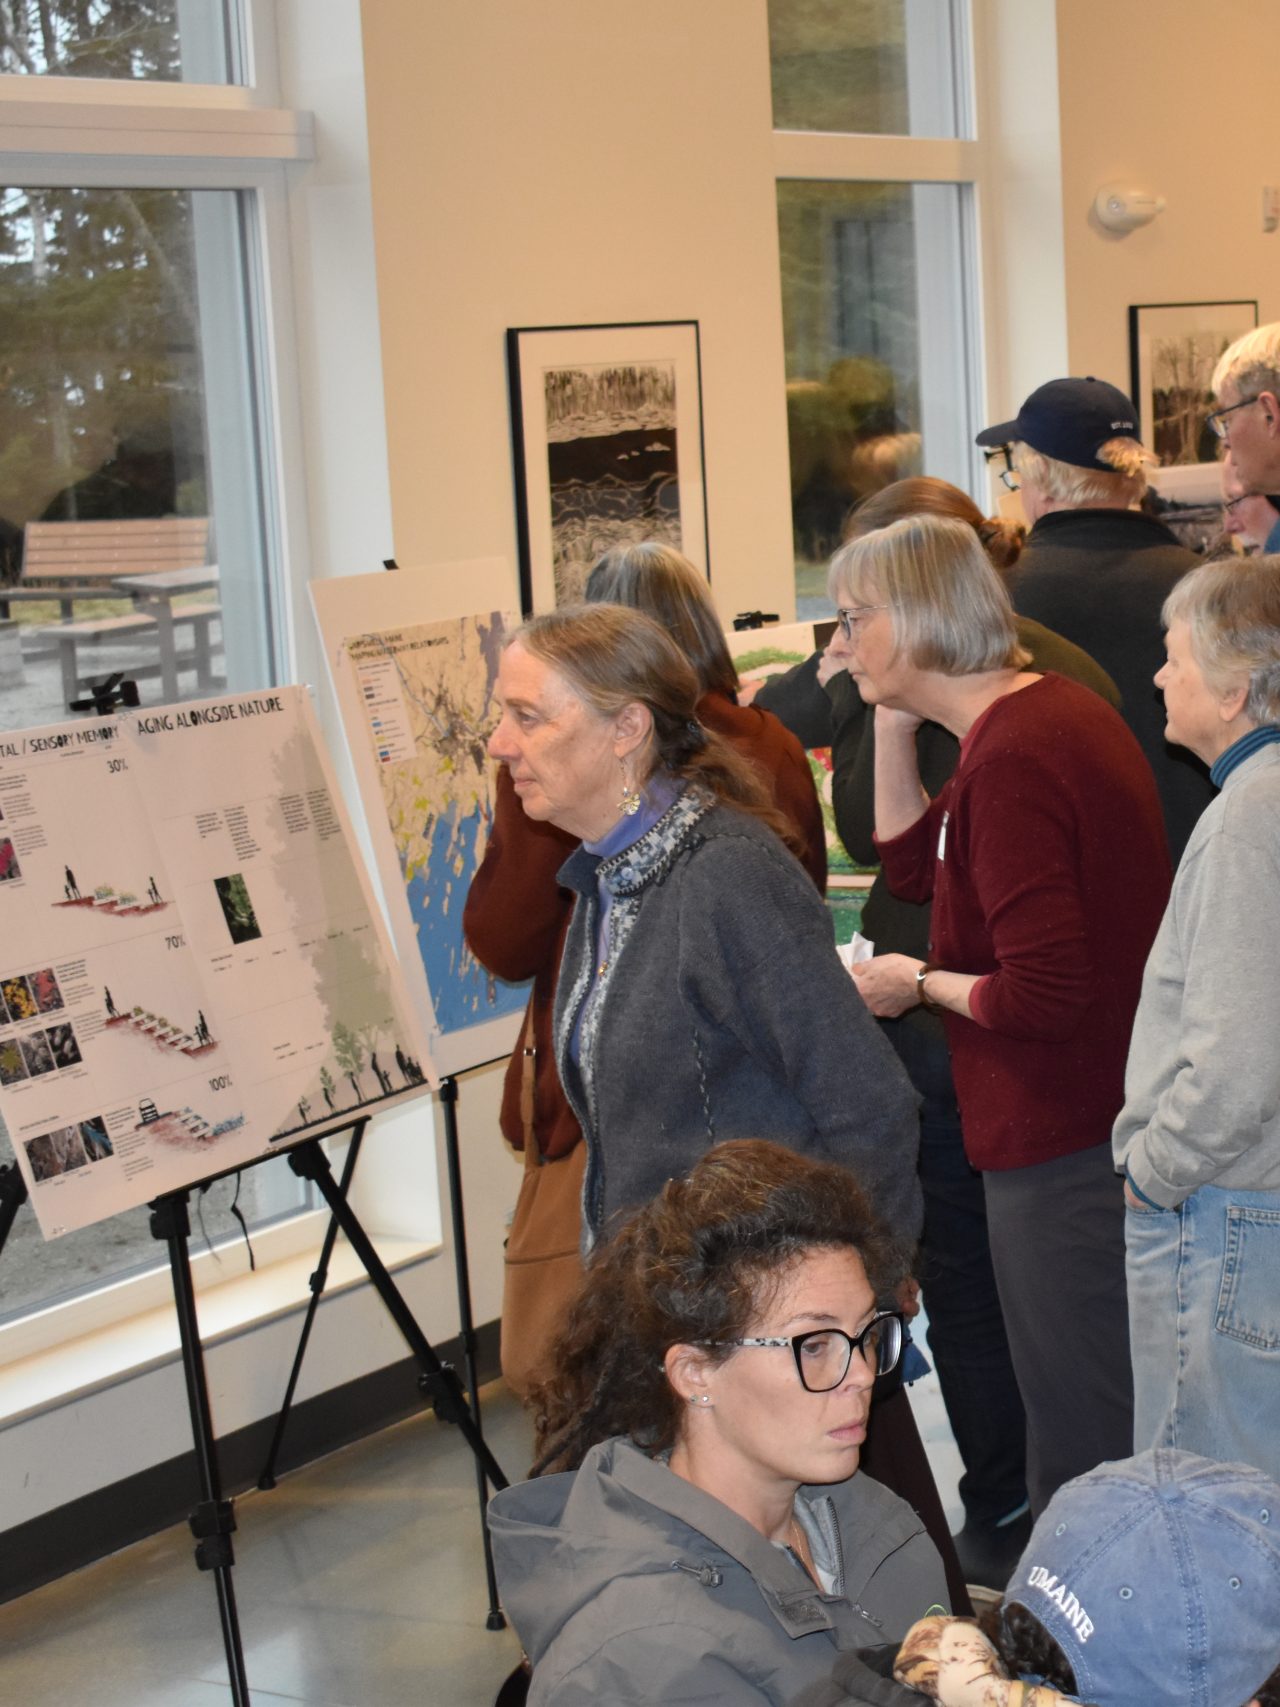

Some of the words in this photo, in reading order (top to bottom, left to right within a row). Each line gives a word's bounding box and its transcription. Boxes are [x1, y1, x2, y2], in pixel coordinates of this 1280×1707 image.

[137, 715, 174, 736] AGING
[176, 704, 238, 729] ALONGSIDE
[239, 697, 285, 717] NATURE
[30, 732, 75, 753] SENSORY
[76, 726, 120, 744] MEMORY
[107, 758, 129, 774] 30%
[165, 934, 186, 951] 70%
[208, 1074, 233, 1092] 100%
[1027, 1565, 1095, 1645] UMAINE
